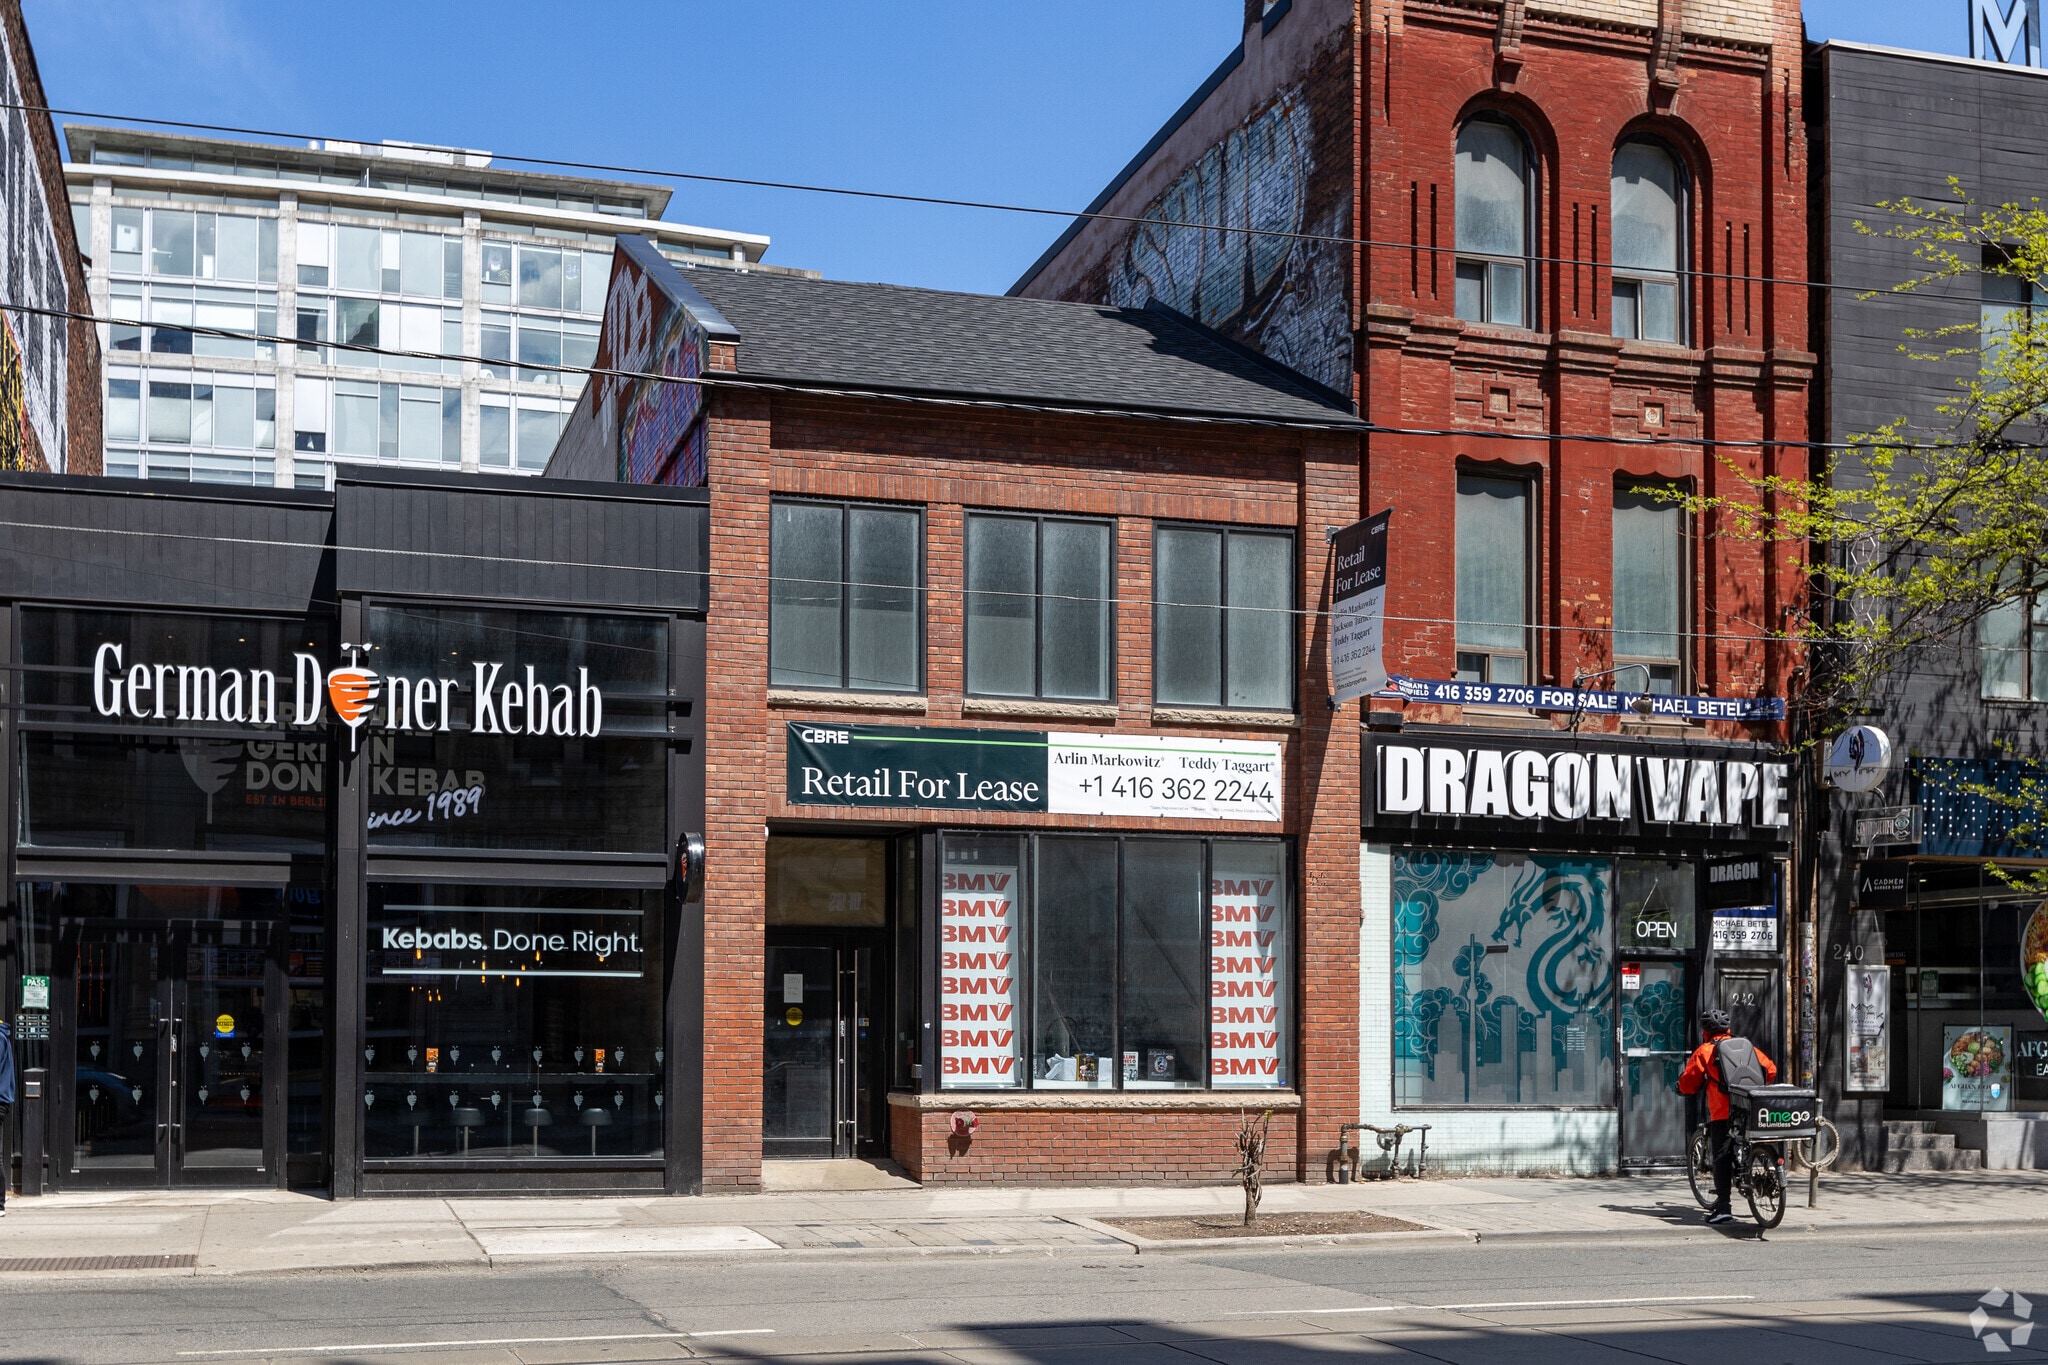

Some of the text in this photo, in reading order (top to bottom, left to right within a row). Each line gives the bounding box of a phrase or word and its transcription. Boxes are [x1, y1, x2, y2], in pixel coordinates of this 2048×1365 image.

[1336, 545, 1366, 572] Retail
[1335, 566, 1381, 594] For Lease
[1350, 648, 1361, 661] 362
[93, 642, 277, 724] German
[471, 660, 602, 738] Kebab
[1434, 684, 1460, 701] 416
[1464, 686, 1492, 702] 359
[1497, 688, 1535, 705] 2706
[1541, 690, 1575, 708] FOR
[1578, 692, 1618, 710] SALE
[801, 728, 850, 745] CBRE
[1054, 752, 1088, 765] Arlin
[1179, 757, 1219, 773] Teddy
[801, 766, 1040, 803] Retail For Lease
[1079, 775, 1275, 803] +1 416 362 2244
[1377, 744, 1790, 829] DRAGON VAPE
[289, 796, 327, 807] BERLI
[366, 785, 484, 829] ince 1989
[1709, 861, 1759, 883] DRAGON
[943, 872, 1011, 891] BMV
[1211, 879, 1274, 896] BMV
[942, 899, 1012, 917] BMV
[1211, 904, 1275, 922] BMV
[942, 925, 1012, 943] BMV
[1211, 929, 1276, 947] BMV
[1636, 920, 1678, 938] OPEN
[1713, 930, 1773, 941] 416 359 2706
[382, 928, 645, 958] Kebabs. Done Right.
[942, 951, 1013, 970] BMV
[1833, 943, 1864, 962] 240
[1211, 955, 1277, 973] BMV
[26, 978, 46, 988] PASS
[942, 976, 1014, 994] BMV
[1211, 979, 1278, 997] BMV
[1732, 992, 1756, 1007] 242
[942, 1003, 1014, 1021] BMV
[1211, 1005, 1279, 1023] BMV
[942, 1028, 1015, 1047] BMV
[1211, 1030, 1280, 1048] BMV
[942, 1055, 1016, 1074] BMV
[1211, 1056, 1281, 1075] BMV
[1758, 1107, 1811, 1126] Amego
